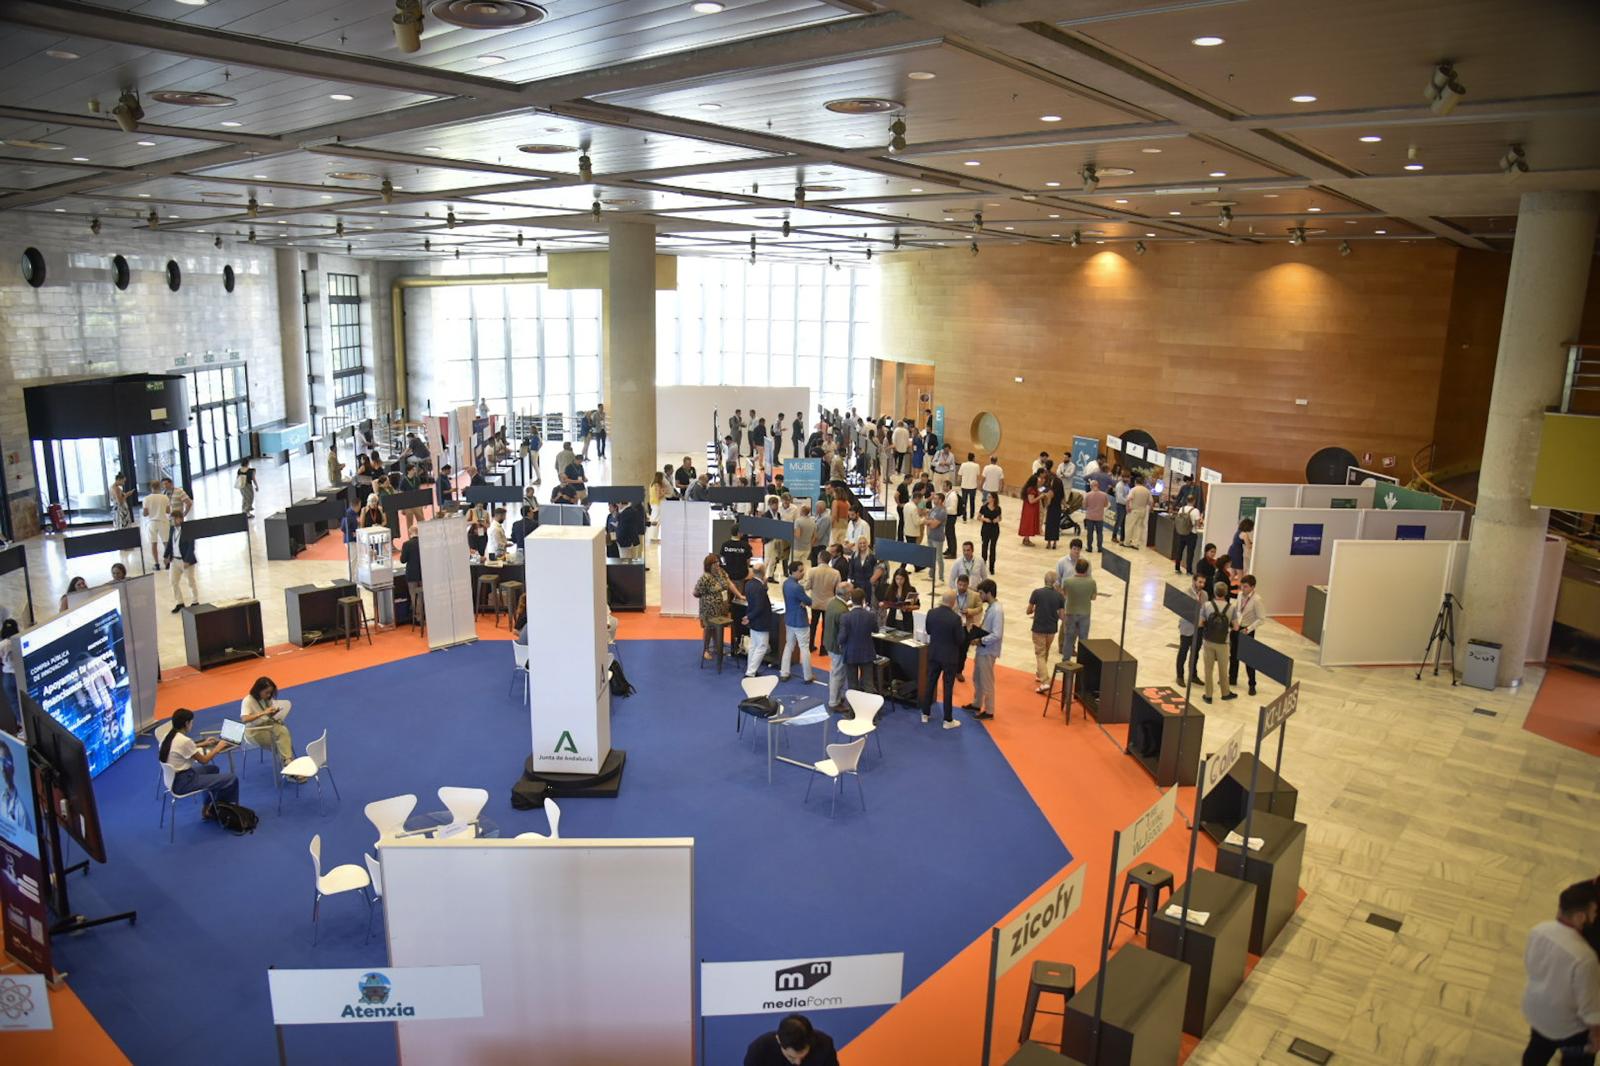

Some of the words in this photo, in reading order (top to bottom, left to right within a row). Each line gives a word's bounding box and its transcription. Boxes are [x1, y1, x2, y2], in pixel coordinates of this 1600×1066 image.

[30, 660, 51, 676] COMPRA
[43, 669, 79, 697] Apoyamos
[1010, 883, 1074, 957] zicofy
[341, 1002, 415, 1018] Atenxia
[763, 996, 842, 1009] mediaform
